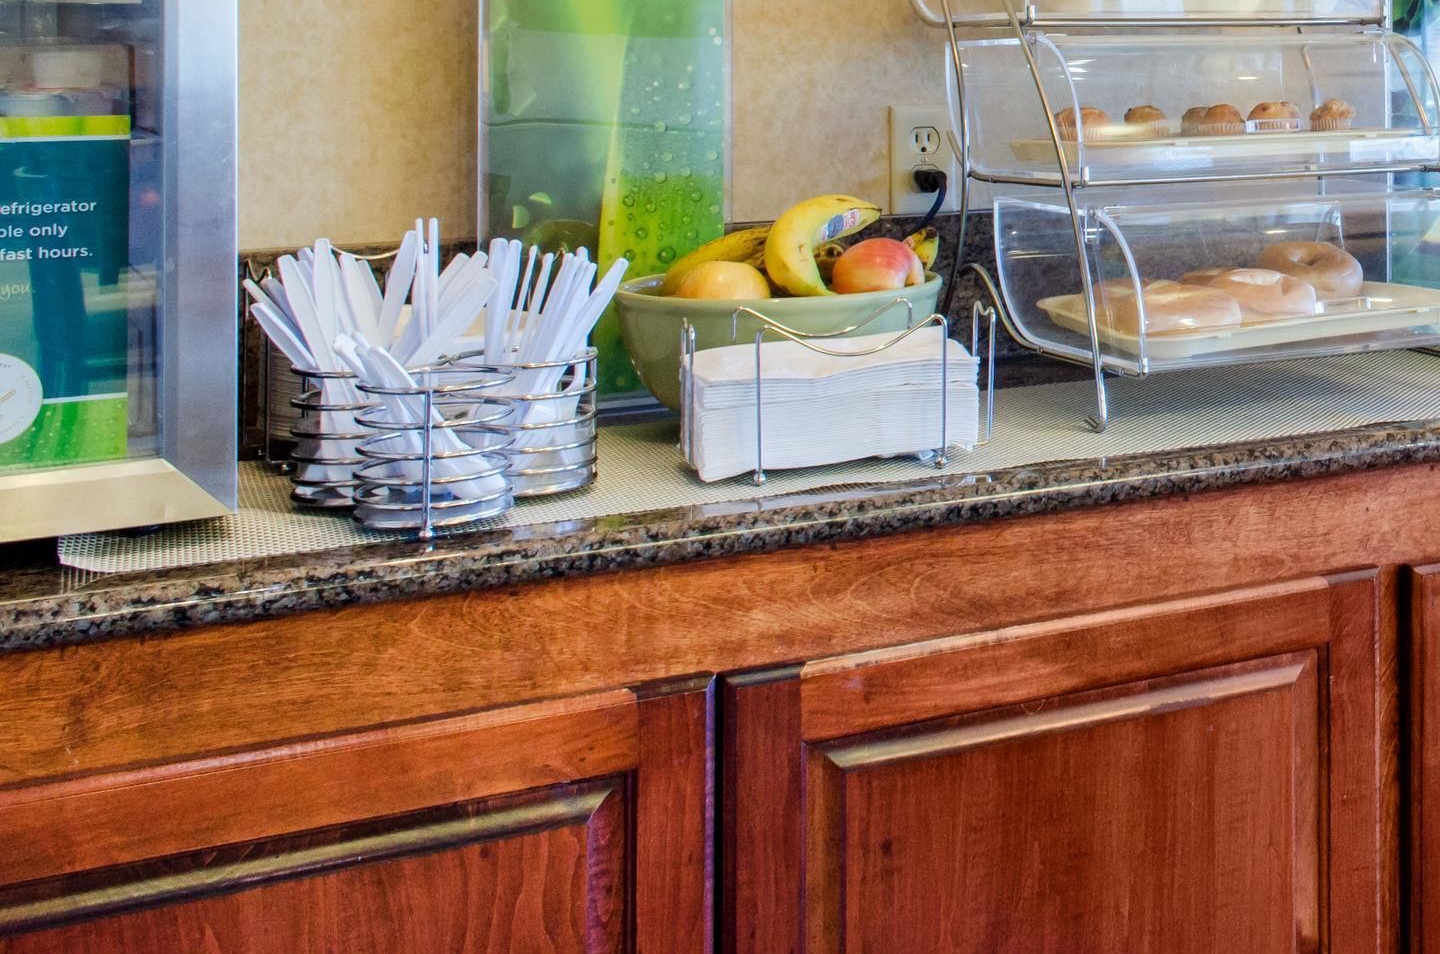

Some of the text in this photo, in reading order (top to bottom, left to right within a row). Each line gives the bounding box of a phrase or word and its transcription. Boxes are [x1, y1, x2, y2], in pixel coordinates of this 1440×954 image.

[0, 200, 97, 216] efrigerator
[29, 223, 68, 238] only
[38, 246, 94, 260] hours.
